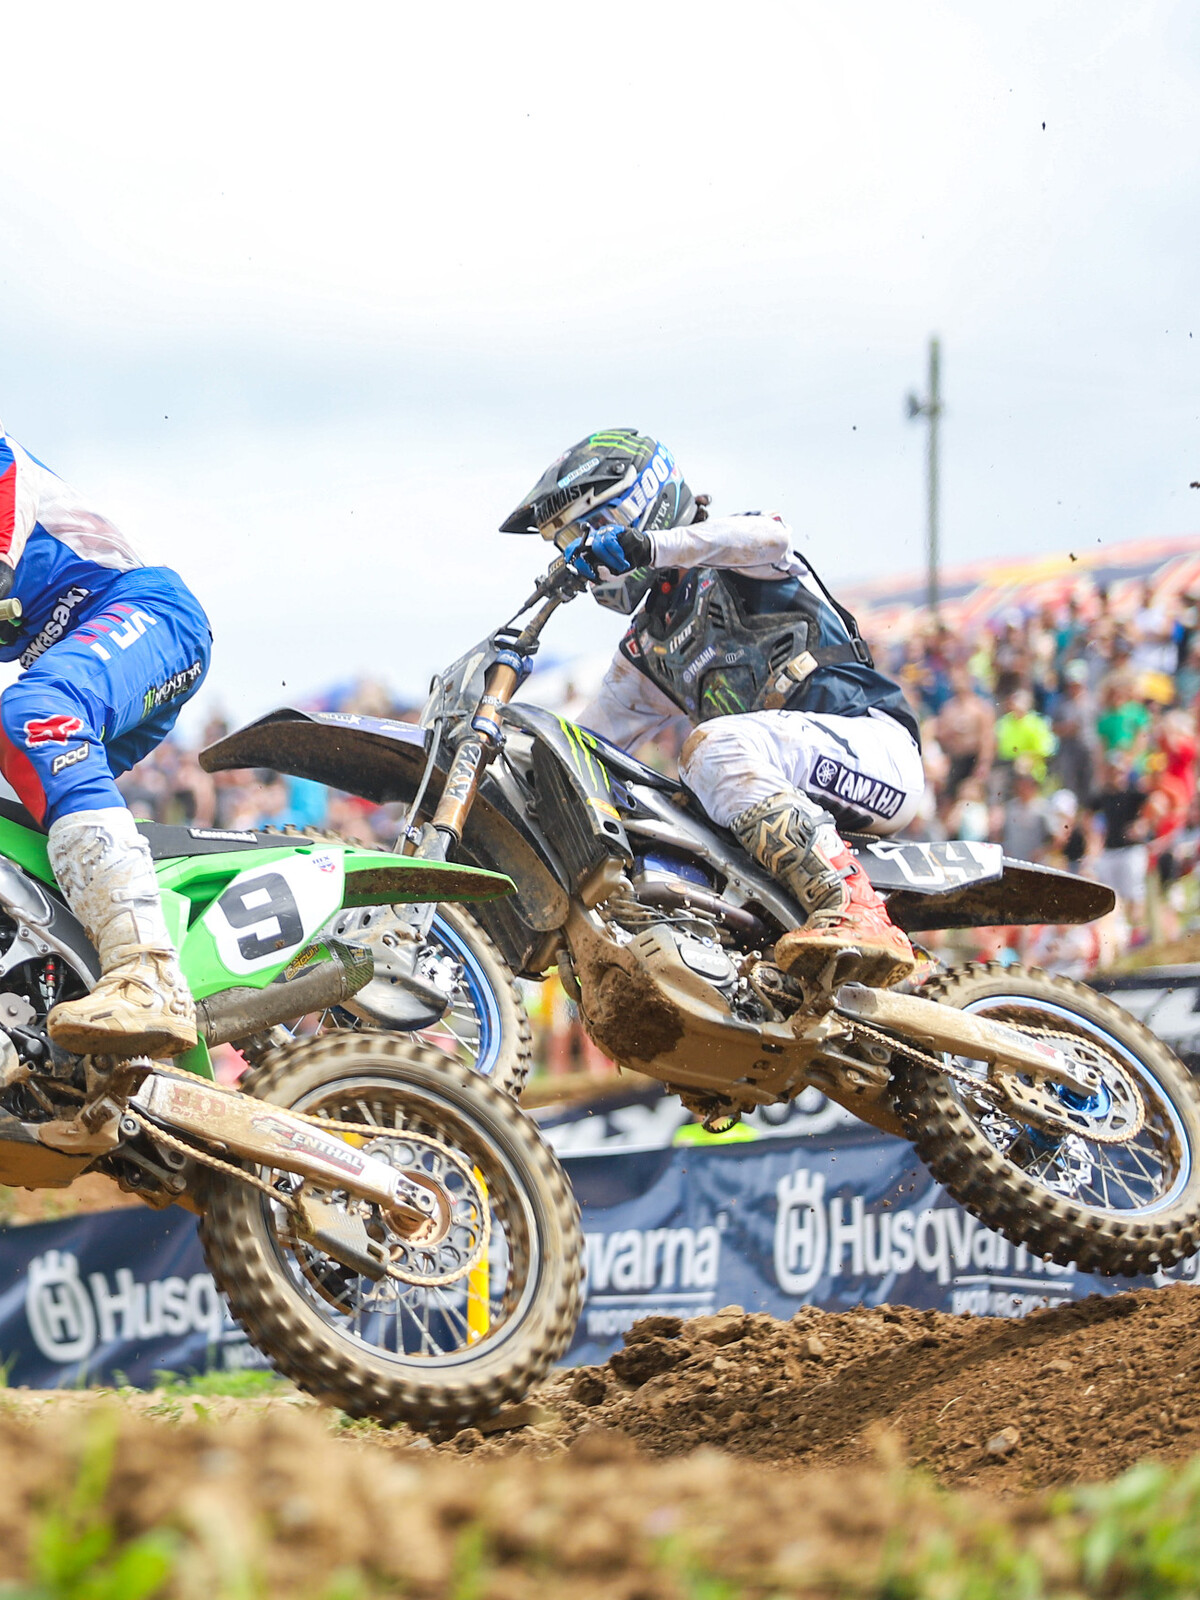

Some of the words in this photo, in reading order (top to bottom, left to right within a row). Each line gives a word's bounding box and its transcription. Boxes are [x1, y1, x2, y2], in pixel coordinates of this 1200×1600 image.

[51, 742, 89, 774] pod
[835, 764, 906, 818] YAMAHA
[216, 872, 304, 960] 9
